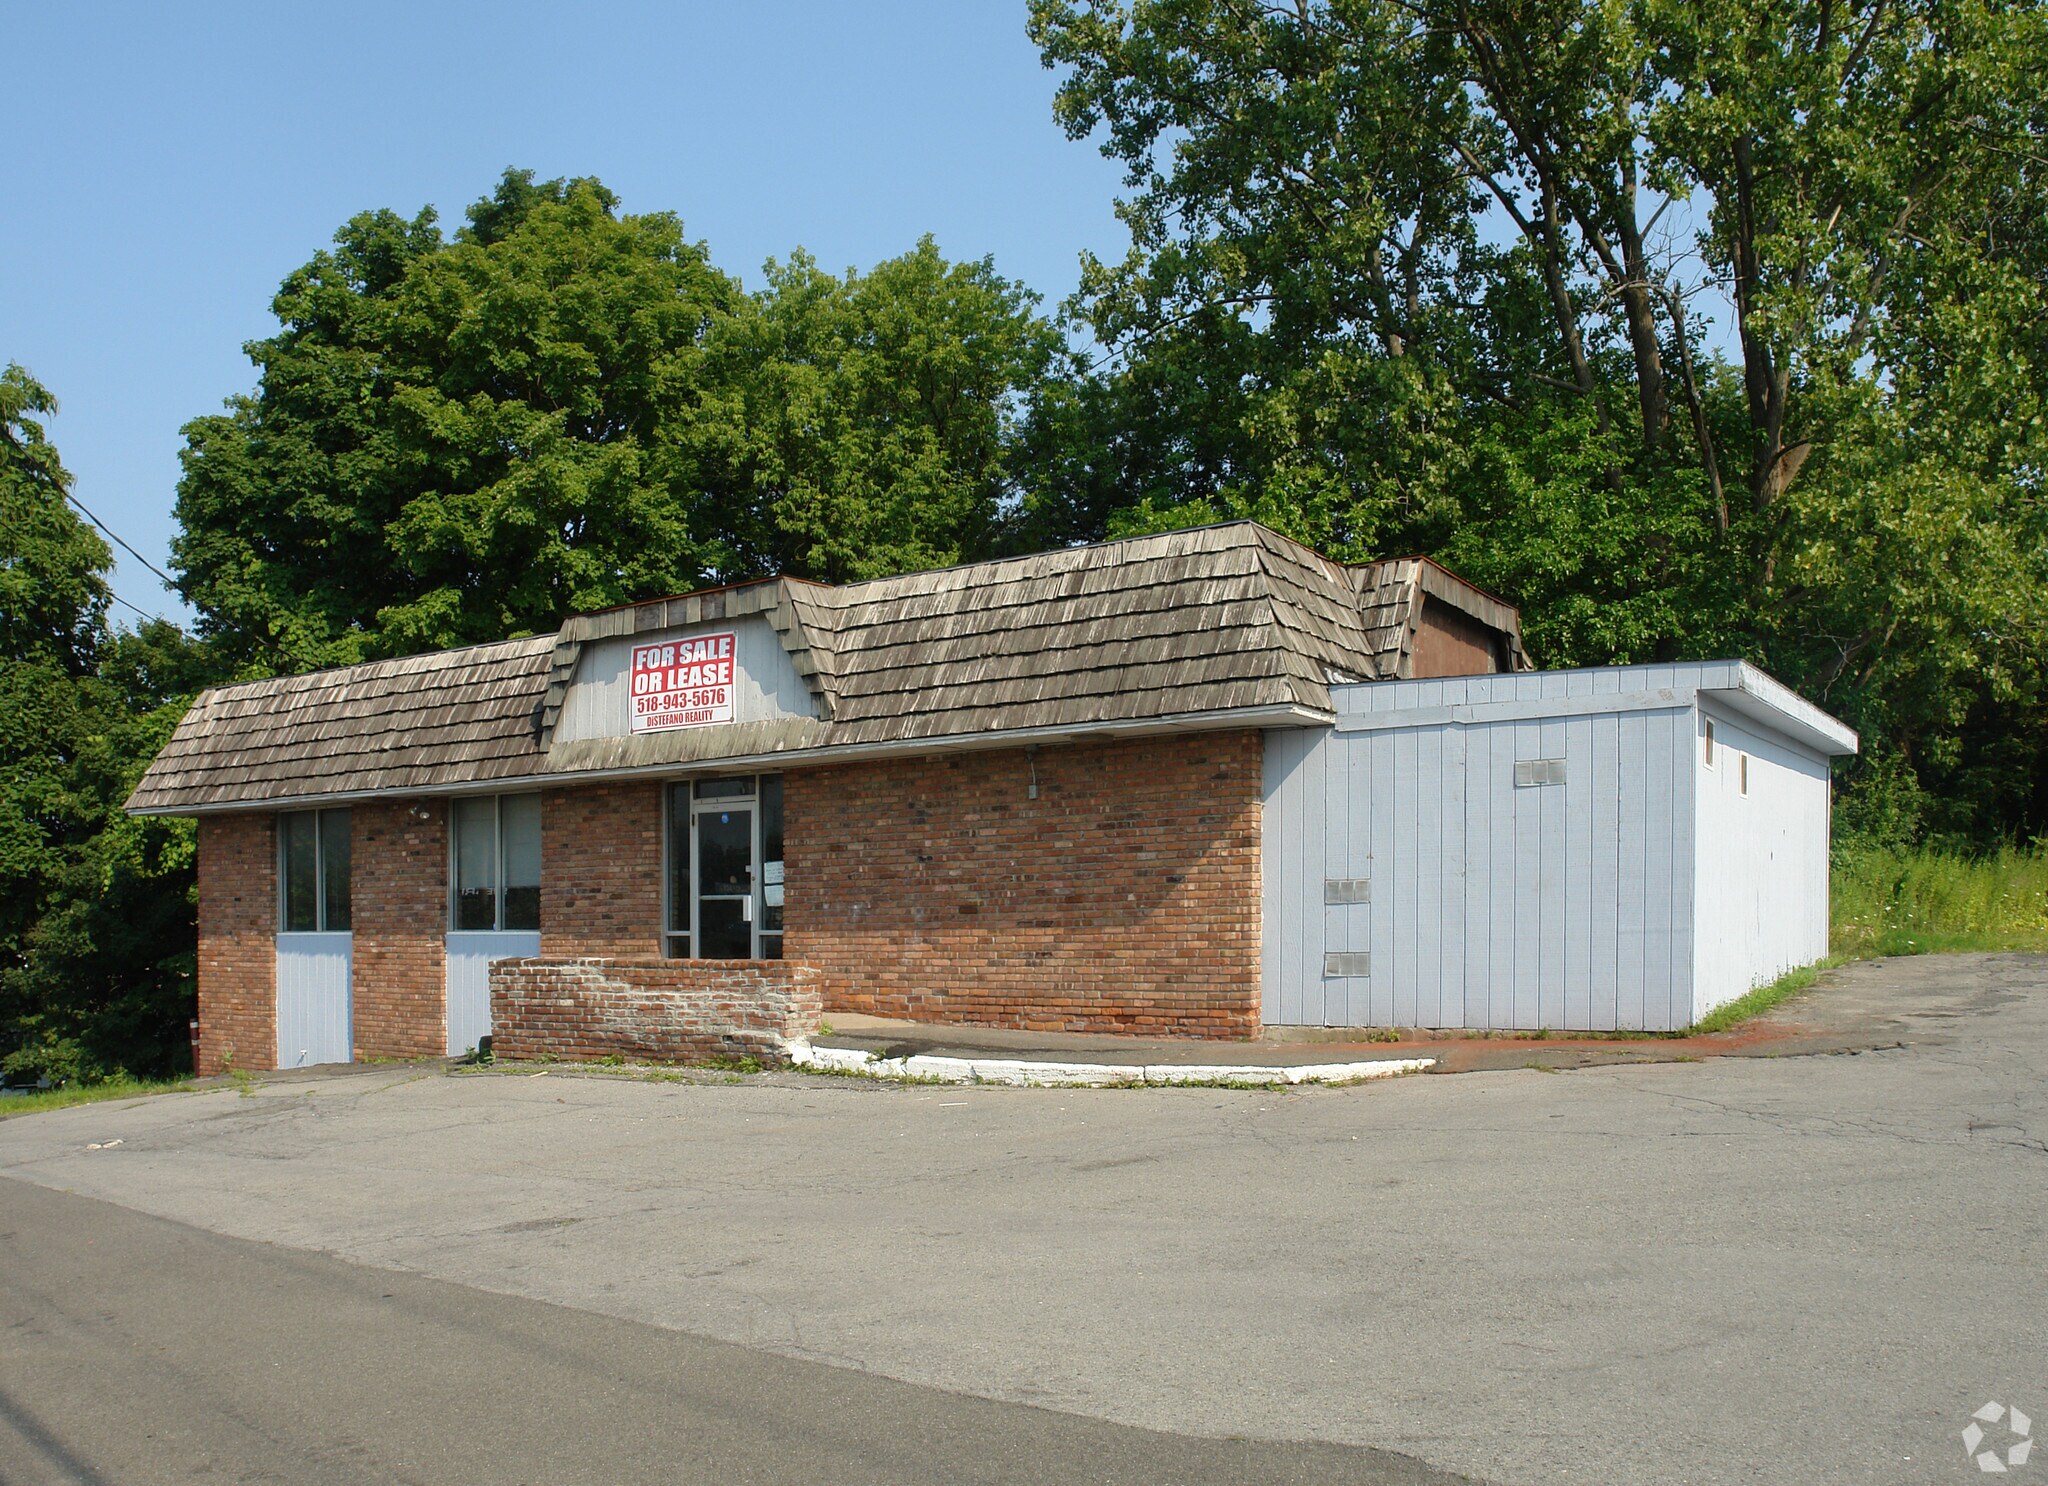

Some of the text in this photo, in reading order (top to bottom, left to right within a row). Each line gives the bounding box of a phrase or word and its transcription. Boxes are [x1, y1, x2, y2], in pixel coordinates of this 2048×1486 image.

[635, 637, 731, 671] FOR SALE
[634, 661, 730, 695] OR LEASE
[637, 687, 726, 713] 518-943-5676
[685, 709, 714, 723] REALITY
